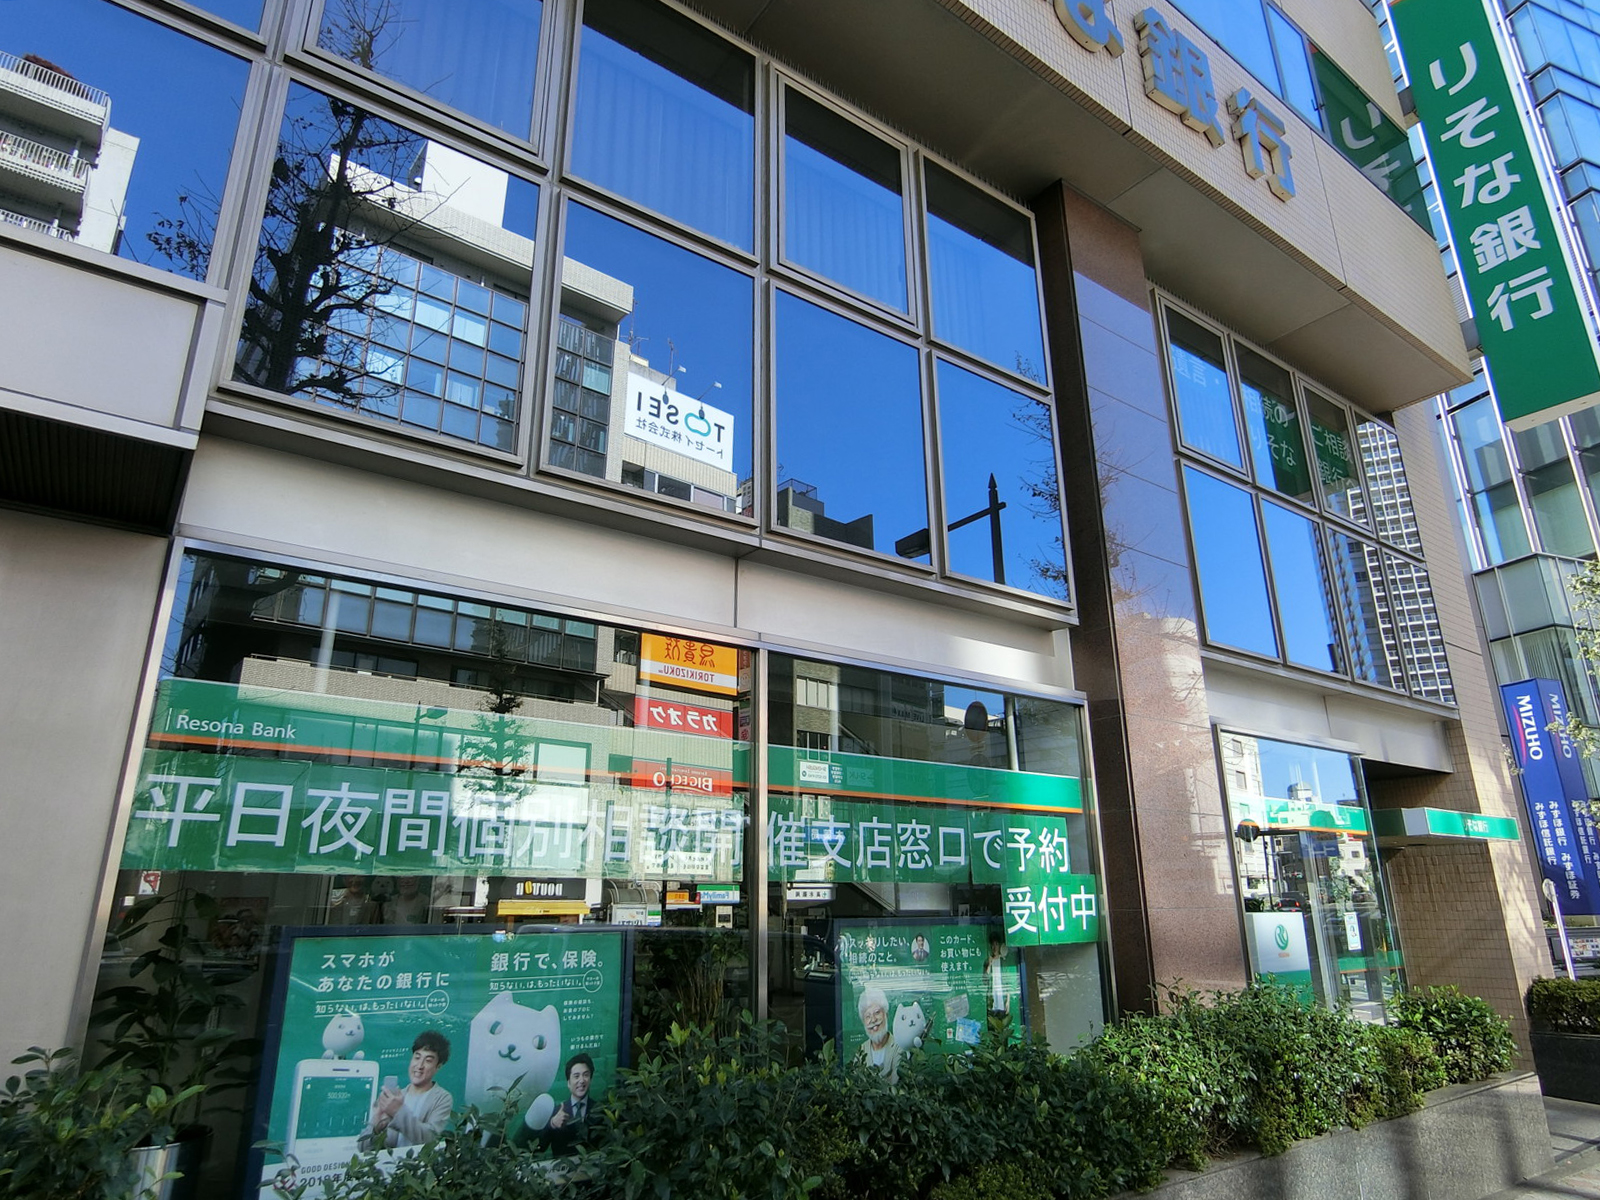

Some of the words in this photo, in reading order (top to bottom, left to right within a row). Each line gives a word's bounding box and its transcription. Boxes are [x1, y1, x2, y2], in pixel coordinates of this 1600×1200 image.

[1429, 41, 1555, 332] りそな銀行
[176, 713, 244, 735] Resona
[251, 722, 296, 740] Bank
[1516, 694, 1543, 760] MIZUHO
[1535, 802, 1557, 866] みずほ信託銀行
[1548, 801, 1568, 846] みずほ銀行
[1561, 853, 1581, 899] みずほ証券
[1005, 885, 1097, 935] 受付中
[940, 934, 975, 945] このカード、
[321, 950, 395, 969] スマホが
[490, 949, 603, 972] 銀行で、保険。
[940, 946, 982, 959] お買い物にも
[940, 961, 973, 973] 使えます。
[317, 971, 450, 993] あなたの銀行に
[301, 1164, 322, 1175] GOOD
